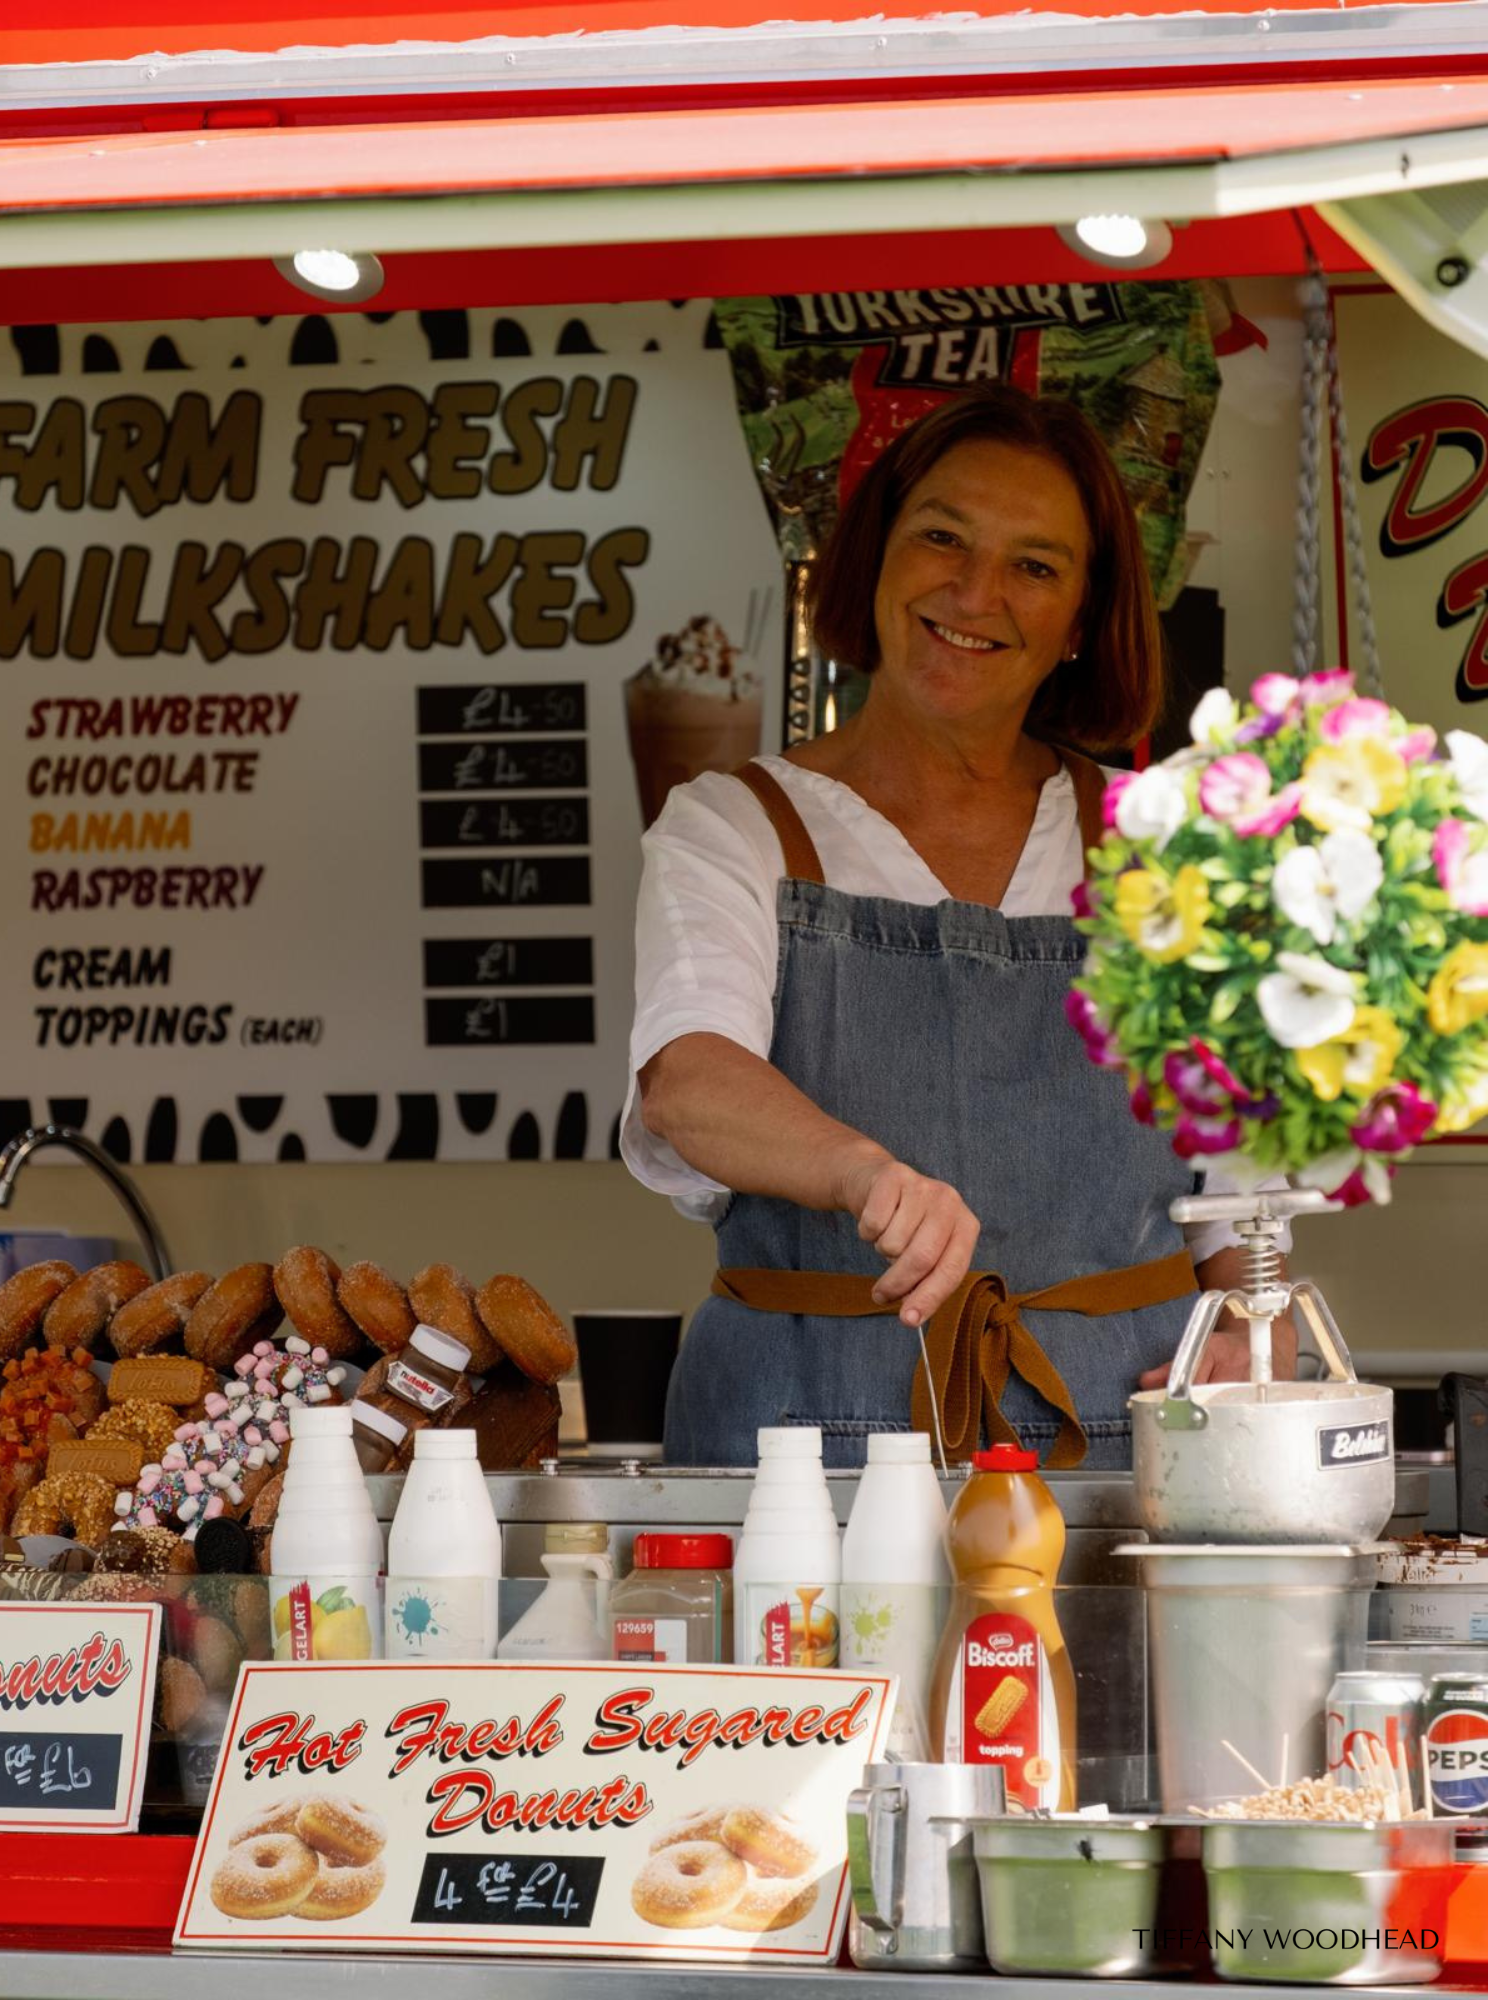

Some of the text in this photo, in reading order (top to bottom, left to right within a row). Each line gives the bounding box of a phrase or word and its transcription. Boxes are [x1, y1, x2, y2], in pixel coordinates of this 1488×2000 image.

[900, 326, 1000, 382] TEA
[291, 375, 638, 508] FRESH
[26, 692, 300, 741] STRAWBERRY
[27, 750, 260, 798] CHOCOLATE
[28, 809, 193, 854] BANANA
[30, 864, 265, 914] RASPBERRY
[480, 858, 540, 903] N/A
[32, 946, 172, 991] CREAM
[475, 941, 517, 981] £1
[34, 1004, 324, 1048] TOPPINGS (EACH)
[463, 997, 508, 1039] £1
[293, 1600, 308, 1660] GELART
[616, 1622, 654, 1634] 129659
[0, 1632, 132, 1710] nuts
[968, 1642, 1035, 1667] Biscoff
[238, 1687, 872, 1781] Hot Fresh Sugared
[978, 1744, 1025, 1758] topping
[425, 1768, 653, 1838] Donuts
[433, 1867, 463, 1911] 4
[514, 1862, 580, 1919] £4
